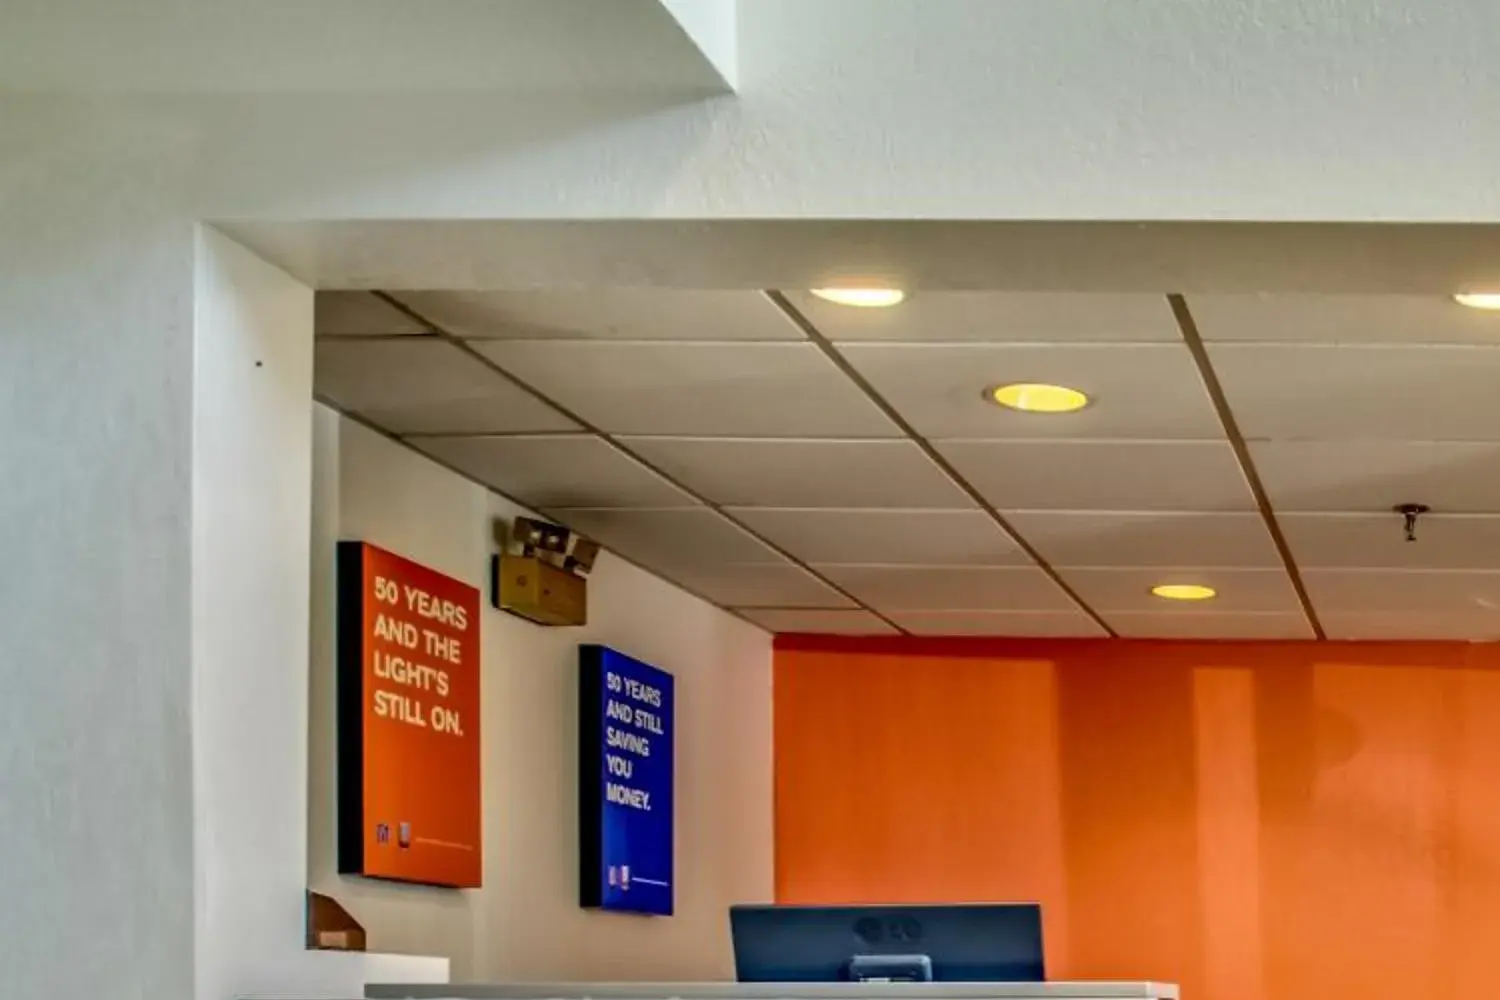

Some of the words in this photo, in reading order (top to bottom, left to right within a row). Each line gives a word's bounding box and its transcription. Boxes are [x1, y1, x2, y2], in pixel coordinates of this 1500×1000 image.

[374, 575, 399, 606] 50
[404, 584, 468, 631] YEARS
[373, 613, 418, 649] AND
[422, 629, 462, 665] THE
[373, 650, 450, 697] LIGHT'S
[606, 671, 622, 693] 50
[623, 677, 662, 708] YEARS
[373, 689, 427, 727] STILL
[431, 705, 465, 737] ON.
[606, 699, 633, 724] AND
[635, 709, 665, 735] STILL
[606, 726, 650, 757] SAVING
[605, 753, 633, 779] YOU
[606, 782, 651, 811] MONEY.
